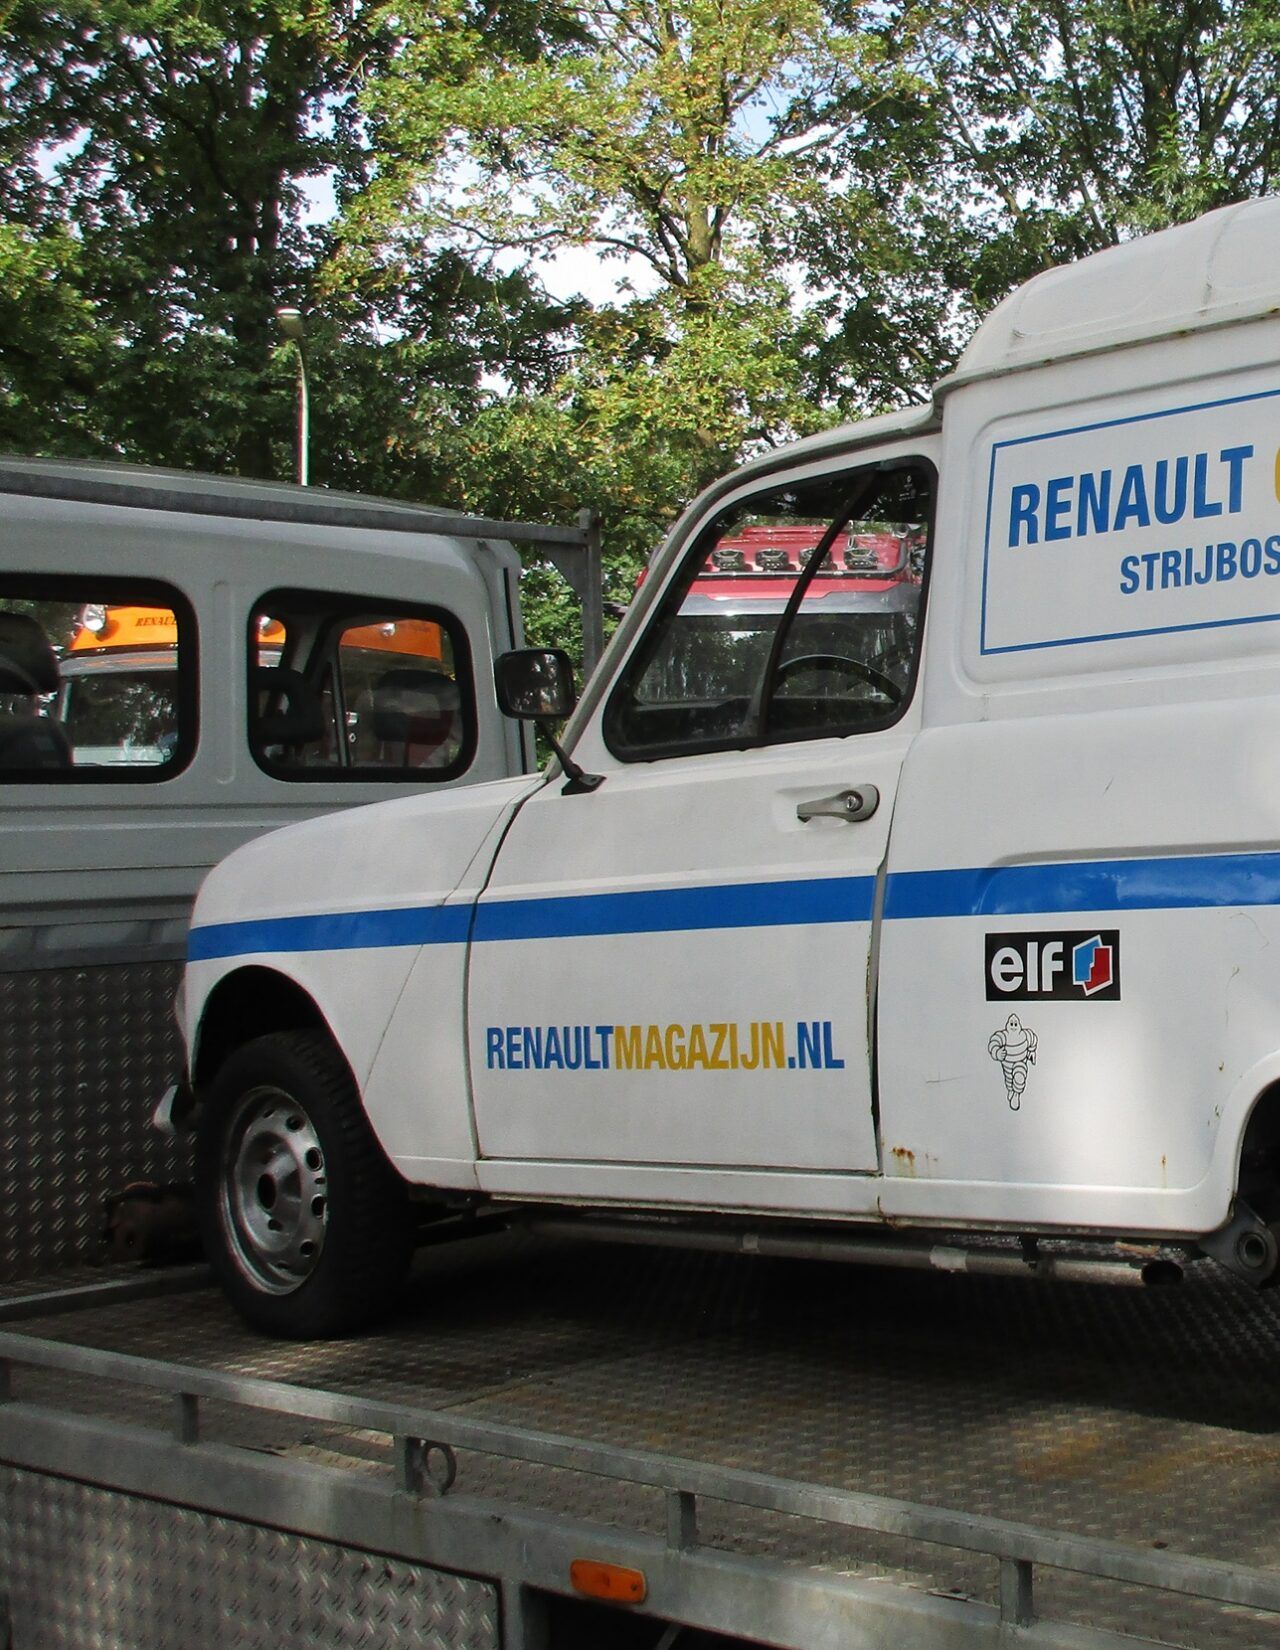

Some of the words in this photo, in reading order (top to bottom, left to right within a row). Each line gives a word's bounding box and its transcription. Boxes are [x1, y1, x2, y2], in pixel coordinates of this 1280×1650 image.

[1008, 445, 1254, 547] RENAULT
[135, 616, 177, 627] RENAUL
[991, 942, 1063, 992] elf
[487, 1021, 844, 1069] RENAULTMAGAZIJN.NL
